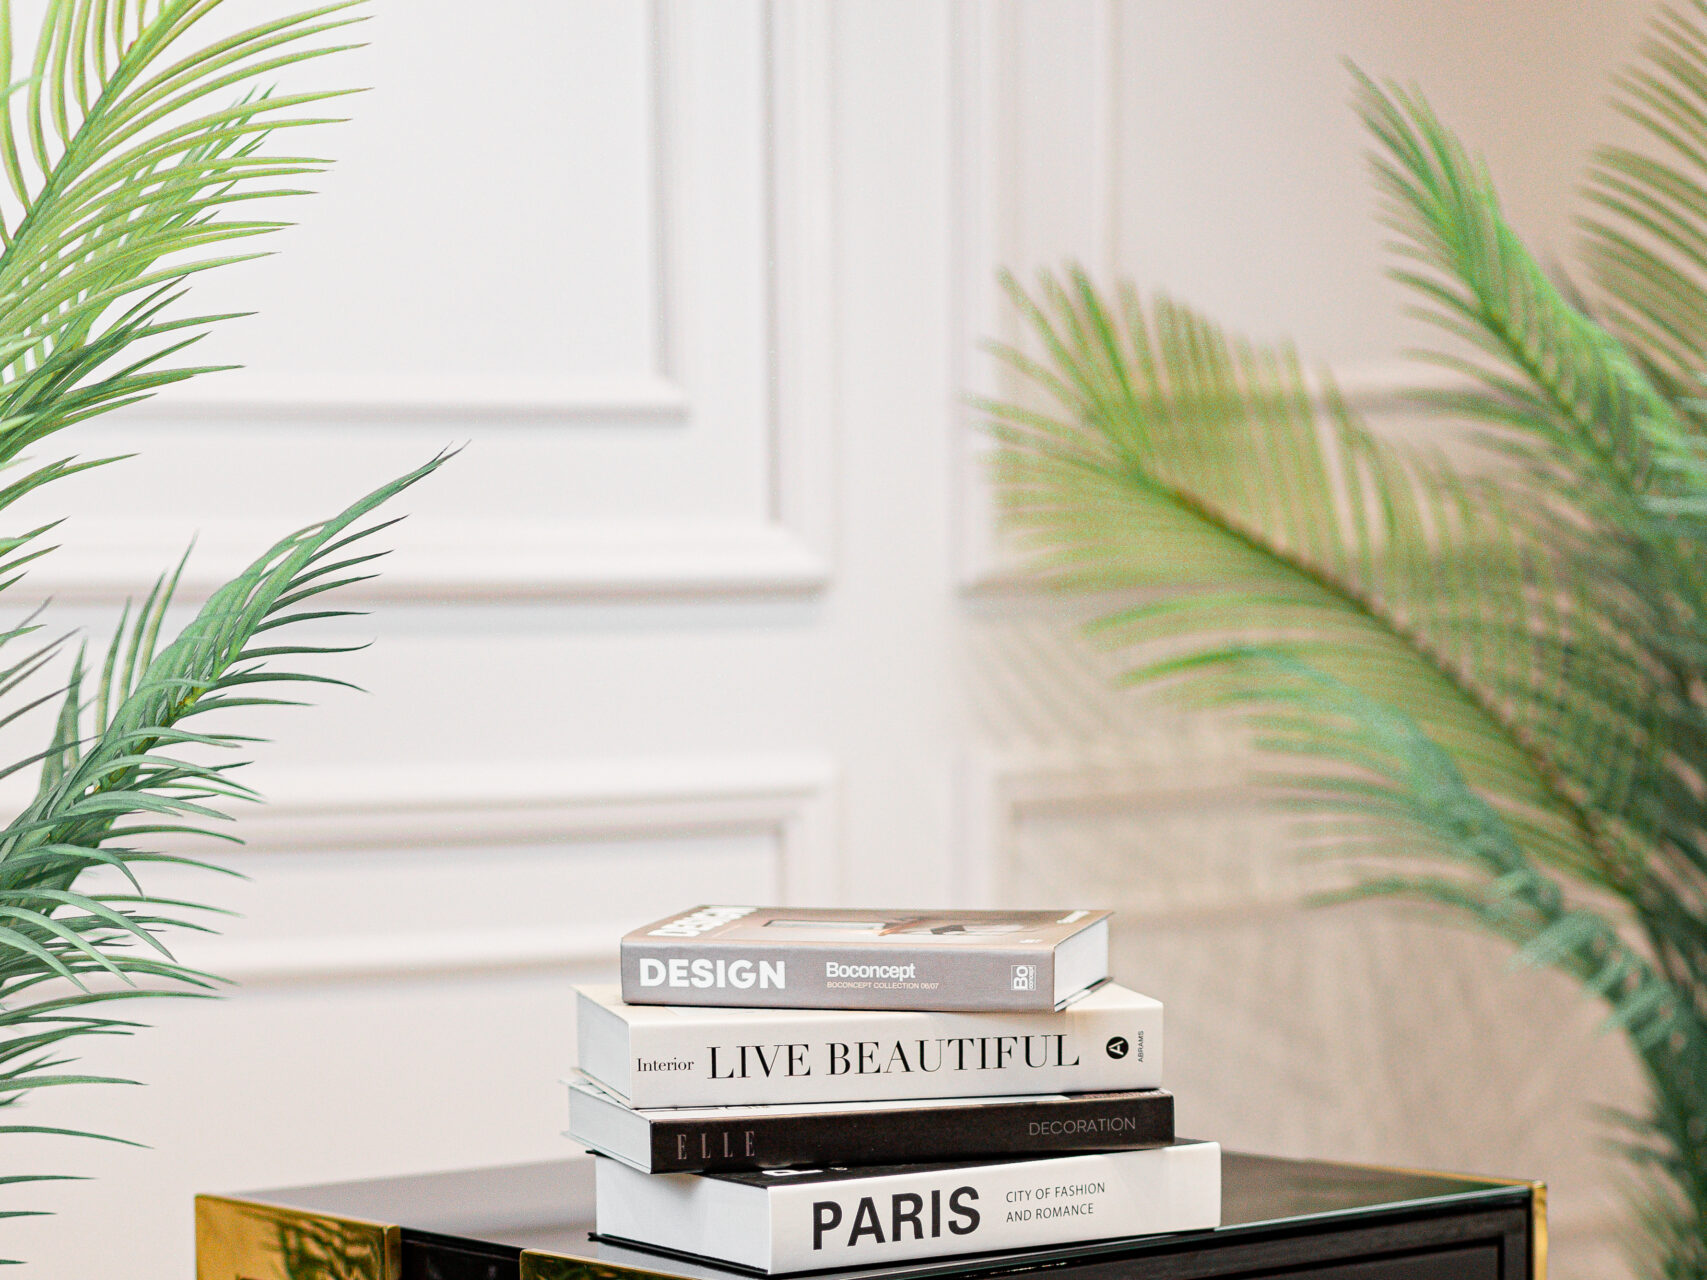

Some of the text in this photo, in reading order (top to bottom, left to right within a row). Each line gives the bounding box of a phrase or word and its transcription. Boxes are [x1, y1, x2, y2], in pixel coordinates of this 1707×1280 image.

[639, 958, 786, 989] DESIGN
[826, 961, 916, 981] Boconcept
[826, 981, 872, 989] BOCONCEPT
[636, 1034, 1080, 1080] Interior LIVE BEAUTIFUL
[1029, 1117, 1136, 1136] DECORATION
[676, 1130, 755, 1160] ELLE
[1006, 1182, 1105, 1203] CITY OF FASHION
[813, 1186, 980, 1251] PARIS
[1006, 1203, 1094, 1223] AND ROMANCE
